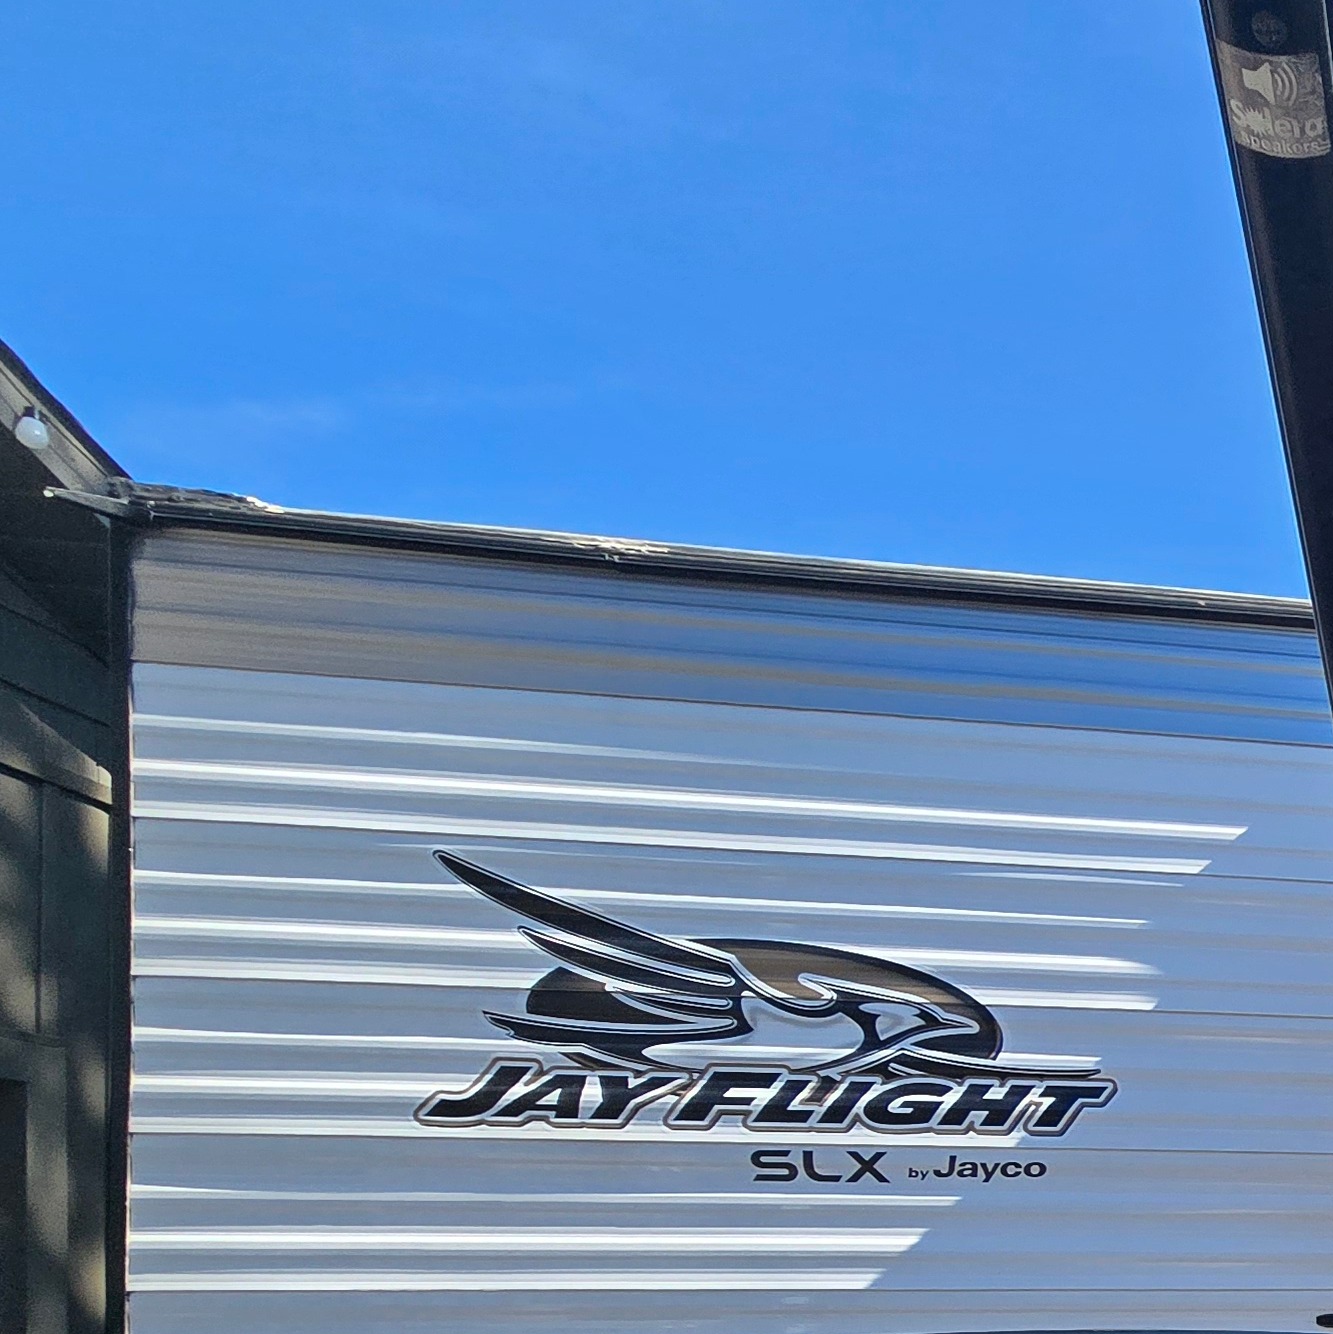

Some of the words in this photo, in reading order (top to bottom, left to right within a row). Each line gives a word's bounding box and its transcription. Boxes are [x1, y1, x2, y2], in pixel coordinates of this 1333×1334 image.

[416, 1058, 691, 1126] JAY
[664, 1064, 1116, 1134] FLIGHT
[751, 1150, 891, 1183] SLX
[908, 1167, 928, 1181] by
[933, 1155, 1047, 1183] Jayco
